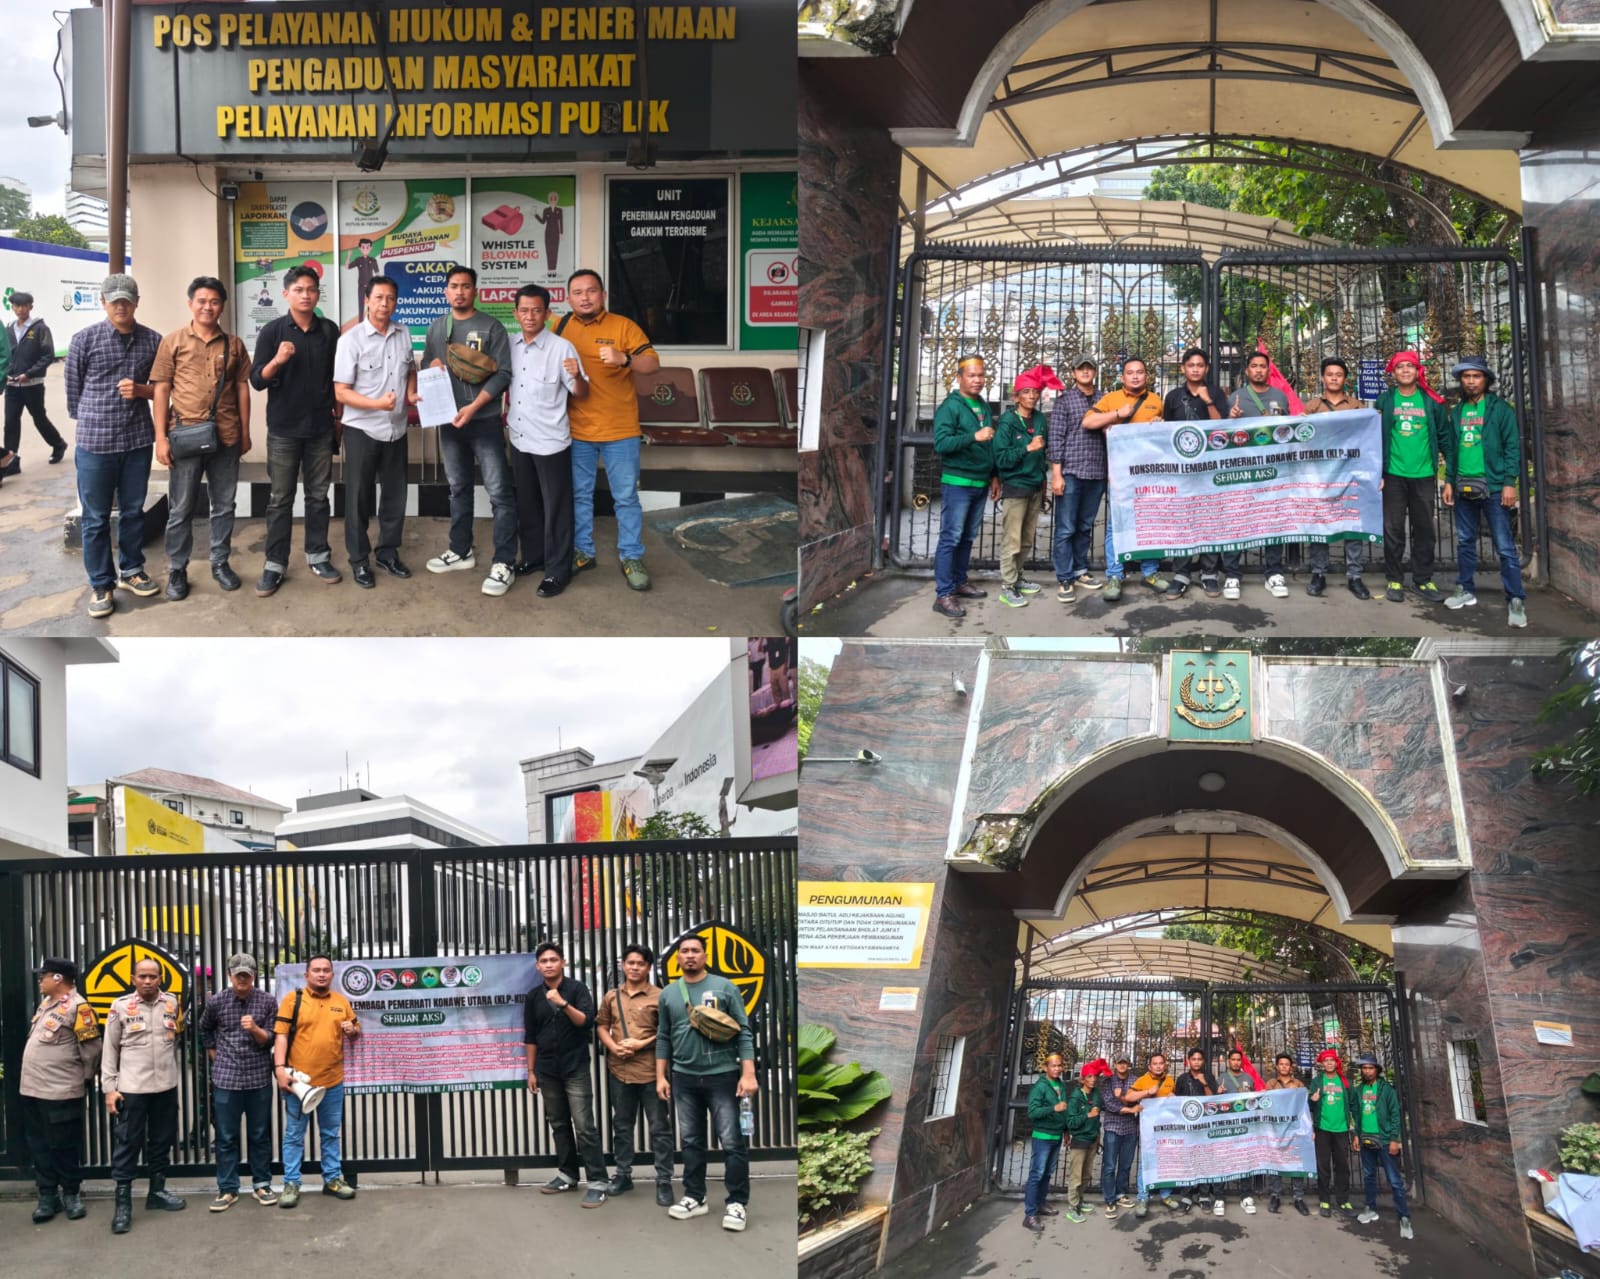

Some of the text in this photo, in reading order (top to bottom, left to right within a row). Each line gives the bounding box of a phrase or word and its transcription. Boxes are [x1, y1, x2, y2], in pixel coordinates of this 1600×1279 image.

[154, 6, 736, 47] POS PELAYANAN HUKUM & PENERMAAN
[248, 53, 636, 91] PENGADUAN MASYARAKAT
[216, 103, 377, 137] PELAYANAN
[385, 102, 552, 137] INFORMASI
[657, 190, 681, 200] UNIT
[622, 210, 716, 220] PENERIMAAN PENGADUAN
[392, 232, 422, 240] BUDAYA
[631, 226, 707, 236] GAKKUM TERORISME
[405, 234, 450, 244] PELAYANAN
[382, 243, 434, 256] PUSPENKUM
[482, 240, 535, 249] WHISTLE
[482, 250, 539, 260] BLOWING
[481, 261, 528, 270] SYSTEM
[1129, 463, 1179, 475] KONSORSIUM
[1181, 460, 1218, 474] LEMBAGA
[1220, 455, 1264, 469] PEMERHATI
[1266, 451, 1297, 463] KONAWE
[1299, 449, 1324, 460] UTARA
[1215, 468, 1275, 483] SERUAN AKSI
[685, 753, 717, 786] Indonesia
[809, 895, 902, 905] PENGUMUMAN
[352, 1000, 386, 1011] LEMBAGA
[388, 998, 431, 1009] PEMERHATI
[433, 996, 465, 1008] KONAWE
[467, 995, 492, 1006] UTARA
[383, 1012, 443, 1023] SERUAN AKSI
